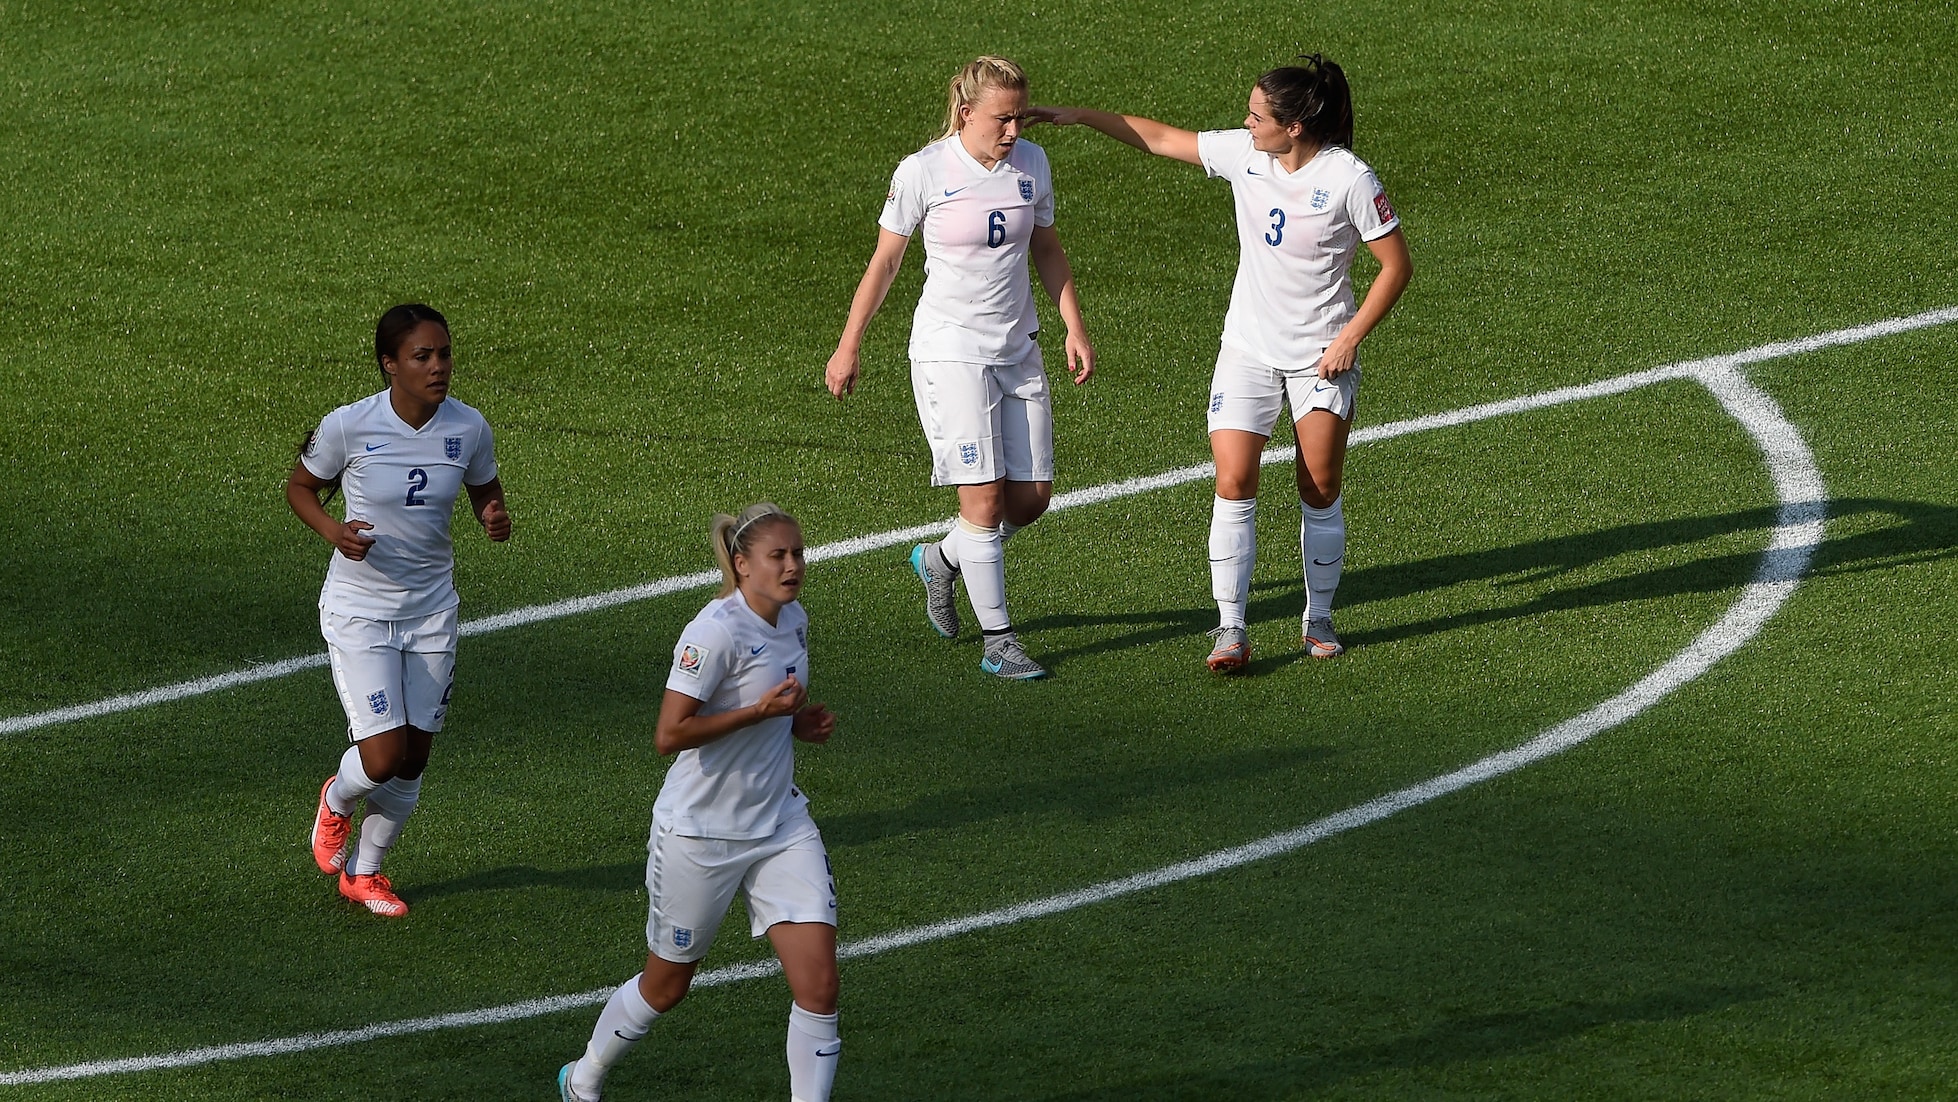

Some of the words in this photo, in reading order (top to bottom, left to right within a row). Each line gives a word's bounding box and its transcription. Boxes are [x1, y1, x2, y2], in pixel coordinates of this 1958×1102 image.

[988, 210, 1006, 249] 6
[1265, 208, 1286, 247] 3
[405, 468, 428, 507] 2
